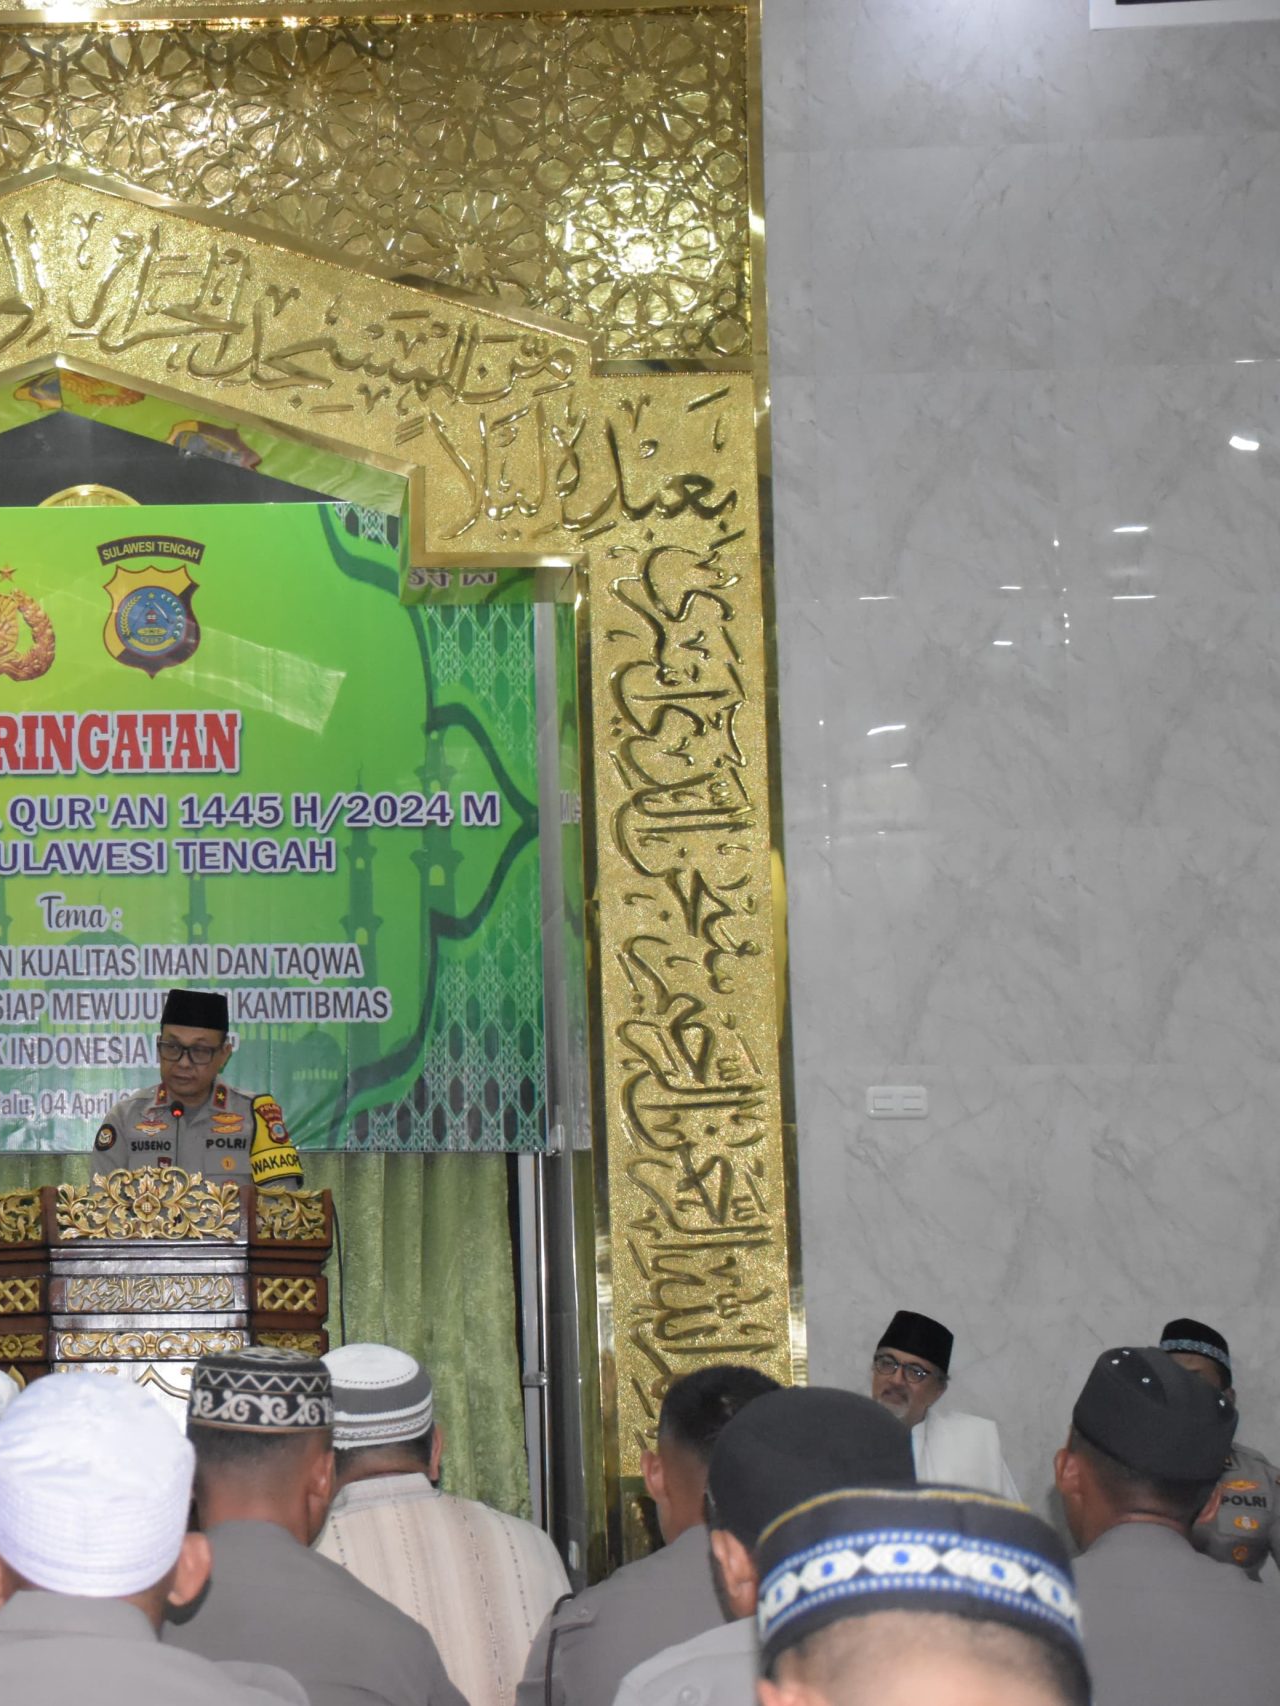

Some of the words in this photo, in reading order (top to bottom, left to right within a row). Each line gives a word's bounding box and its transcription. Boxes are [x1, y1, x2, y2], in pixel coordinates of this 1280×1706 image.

[102, 541, 154, 560] SULAWESI
[157, 541, 201, 560] TENGAH
[9, 797, 165, 832] QUR'AN
[180, 795, 282, 825] 1445
[294, 794, 451, 831] H/2024
[463, 794, 498, 824] M
[176, 840, 334, 870] TENGAH
[39, 895, 108, 929] Tema
[21, 948, 137, 977] KUALITAS
[144, 948, 209, 976] IMAN
[217, 947, 268, 975] DAN
[274, 947, 361, 980] TAQWA
[237, 989, 389, 1019] KAMTIBMAS
[10, 1036, 148, 1066] INDONESIA
[41, 1093, 68, 1115] 04
[72, 1092, 113, 1119] April
[131, 1140, 172, 1152] SUSENO
[206, 1138, 247, 1150] POLRI
[1221, 1495, 1267, 1508] POLRI
